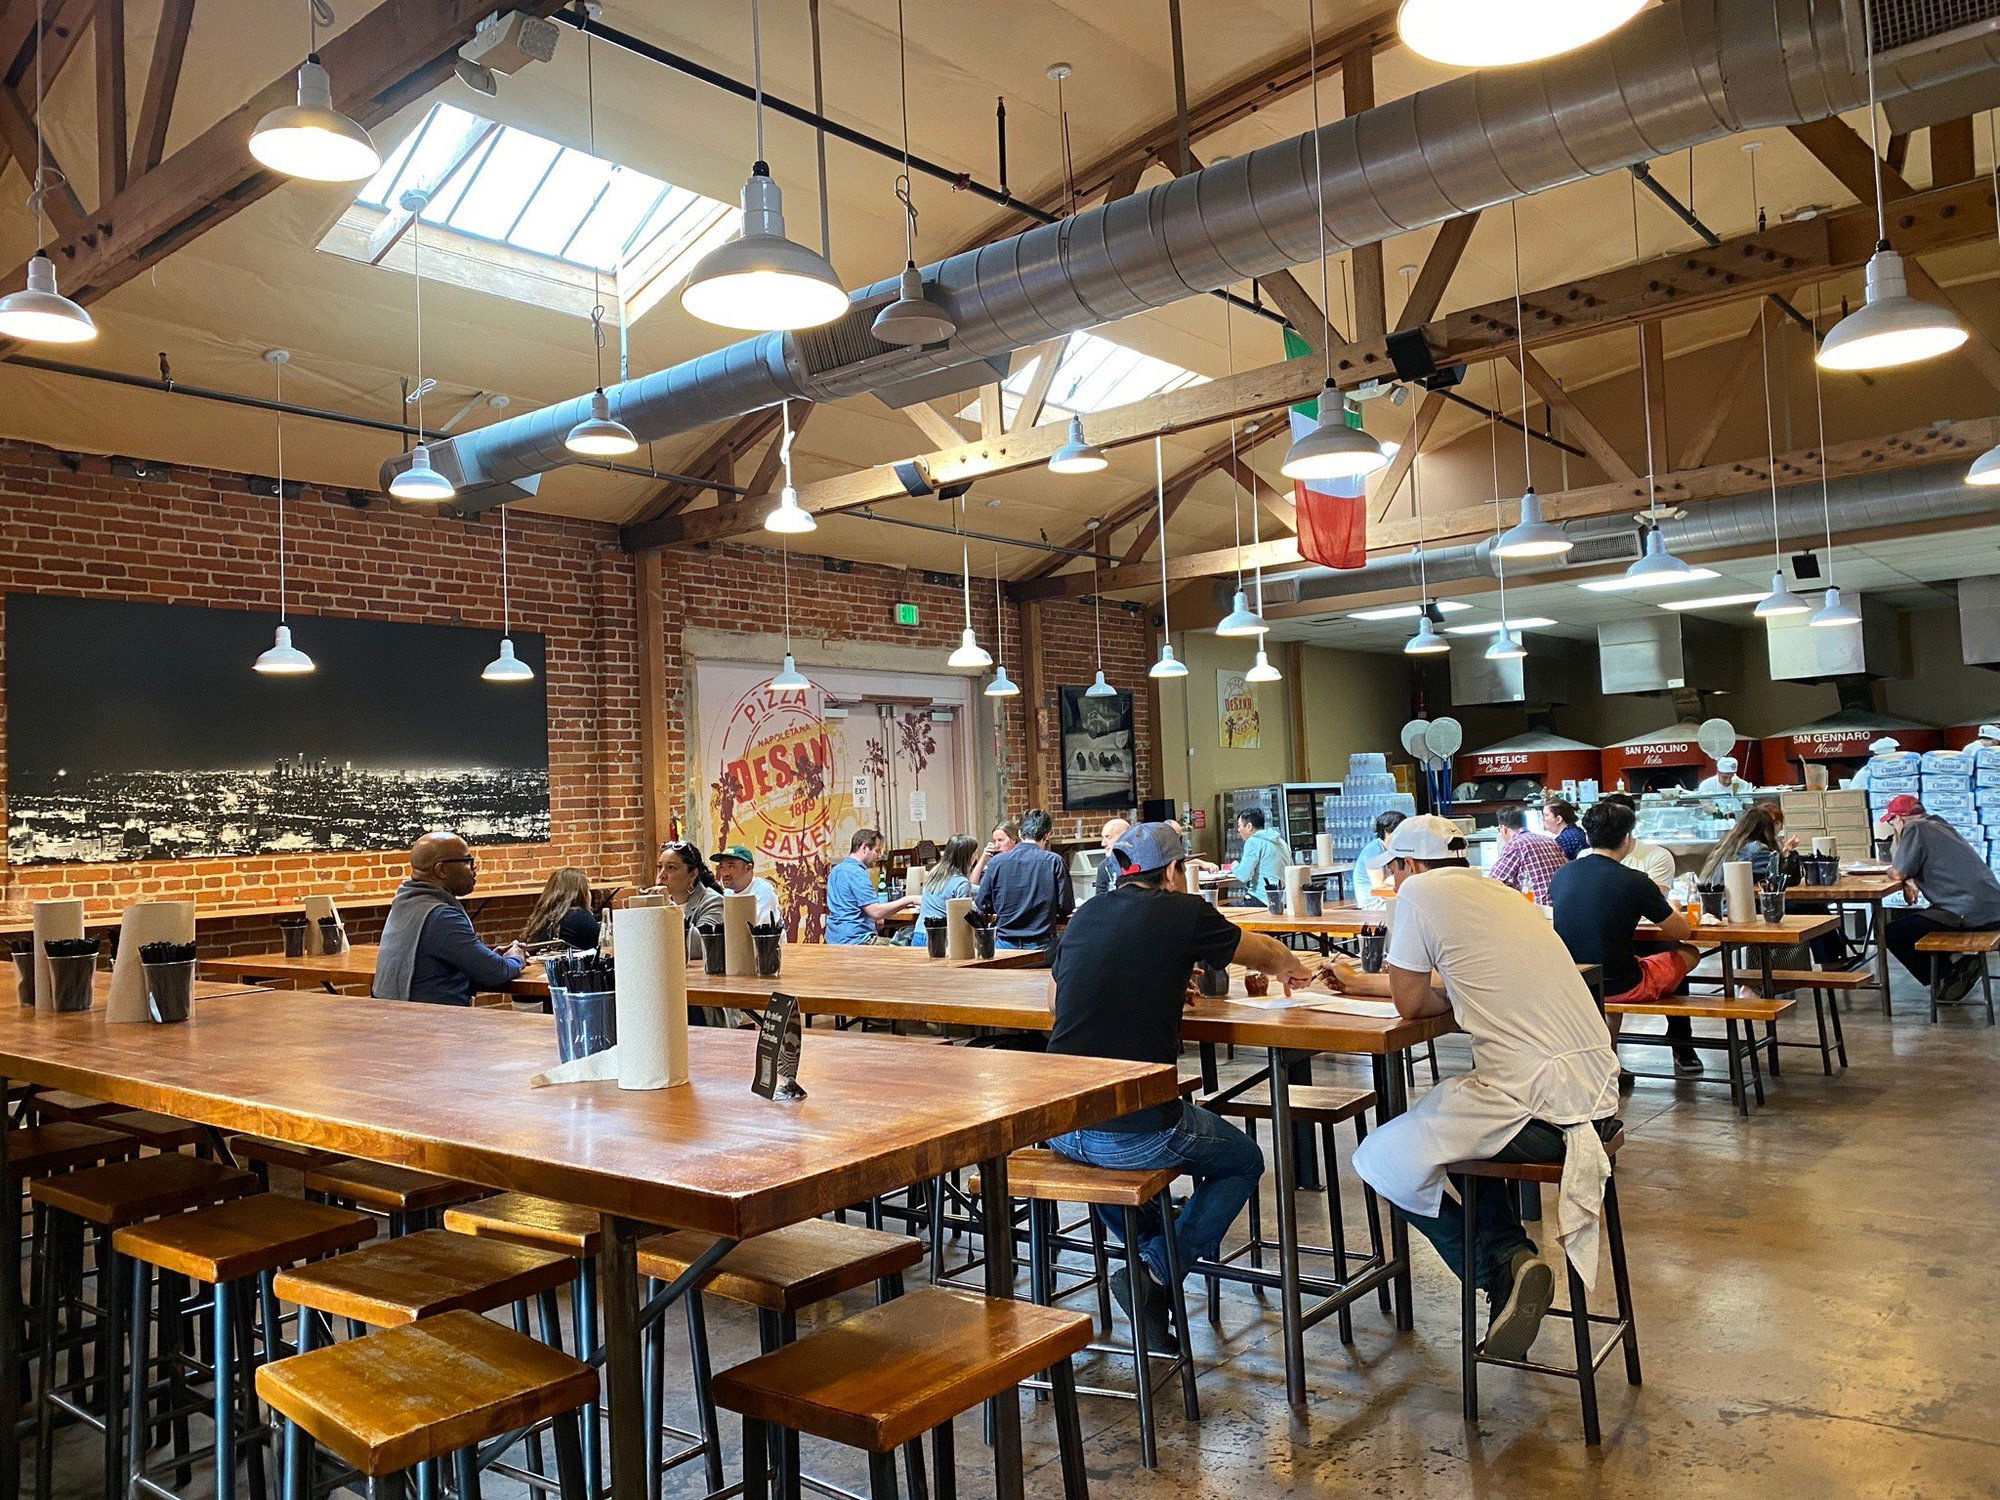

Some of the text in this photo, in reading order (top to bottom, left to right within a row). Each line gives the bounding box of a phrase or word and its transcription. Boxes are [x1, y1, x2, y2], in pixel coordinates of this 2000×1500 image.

[744, 689, 806, 724] PIZZA
[757, 724, 811, 747] NAPOLETANA
[1793, 731, 1871, 744] SAN GENNARO
[1625, 744, 1688, 755] SAN PAOLINO
[1478, 755, 1528, 765] SAN FELICE
[789, 799, 816, 819] 1889
